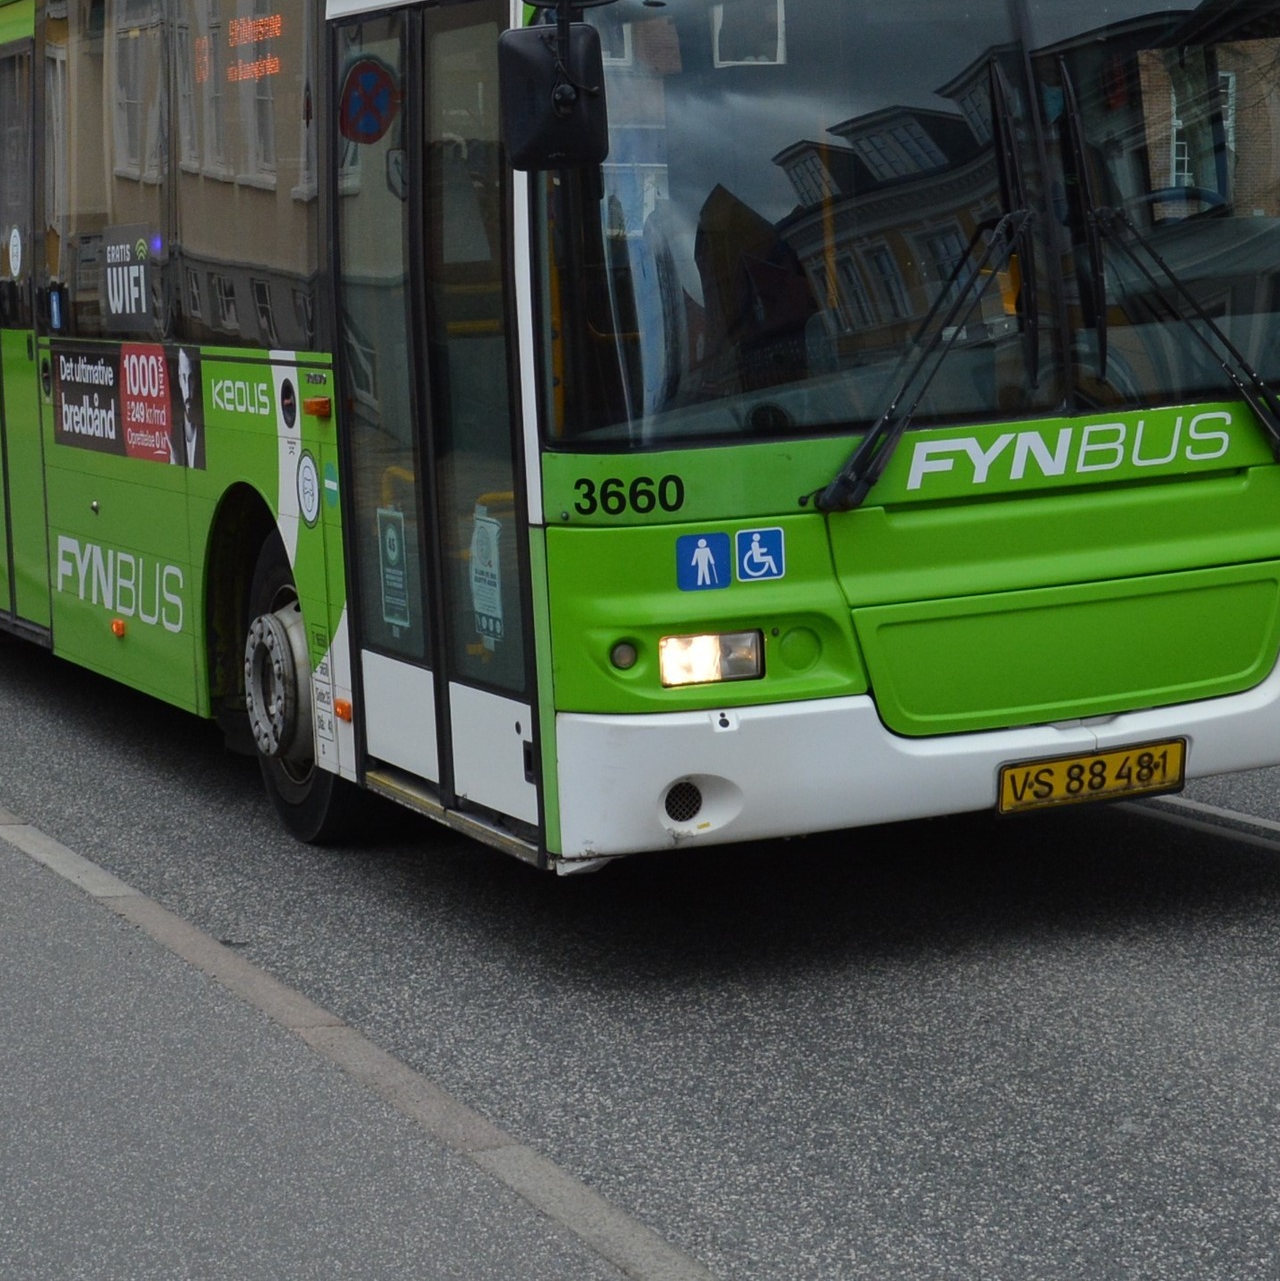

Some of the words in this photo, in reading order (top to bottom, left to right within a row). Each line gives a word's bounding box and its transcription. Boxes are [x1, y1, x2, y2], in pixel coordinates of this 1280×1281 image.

[106, 244, 131, 264] GRATIS
[107, 265, 147, 315] WIFI
[60, 355, 74, 381] Det
[74, 356, 114, 386] ultimative
[124, 354, 158, 397] 1000
[62, 392, 116, 440] bredbånd
[131, 402, 145, 423] 249
[906, 411, 1232, 490] FYNBUS
[574, 474, 685, 515] 3660
[58, 535, 184, 633] FYNBUS
[1010, 768, 1055, 802] VS
[1065, 759, 1107, 795] 88
[1115, 749, 1168, 785] 481
